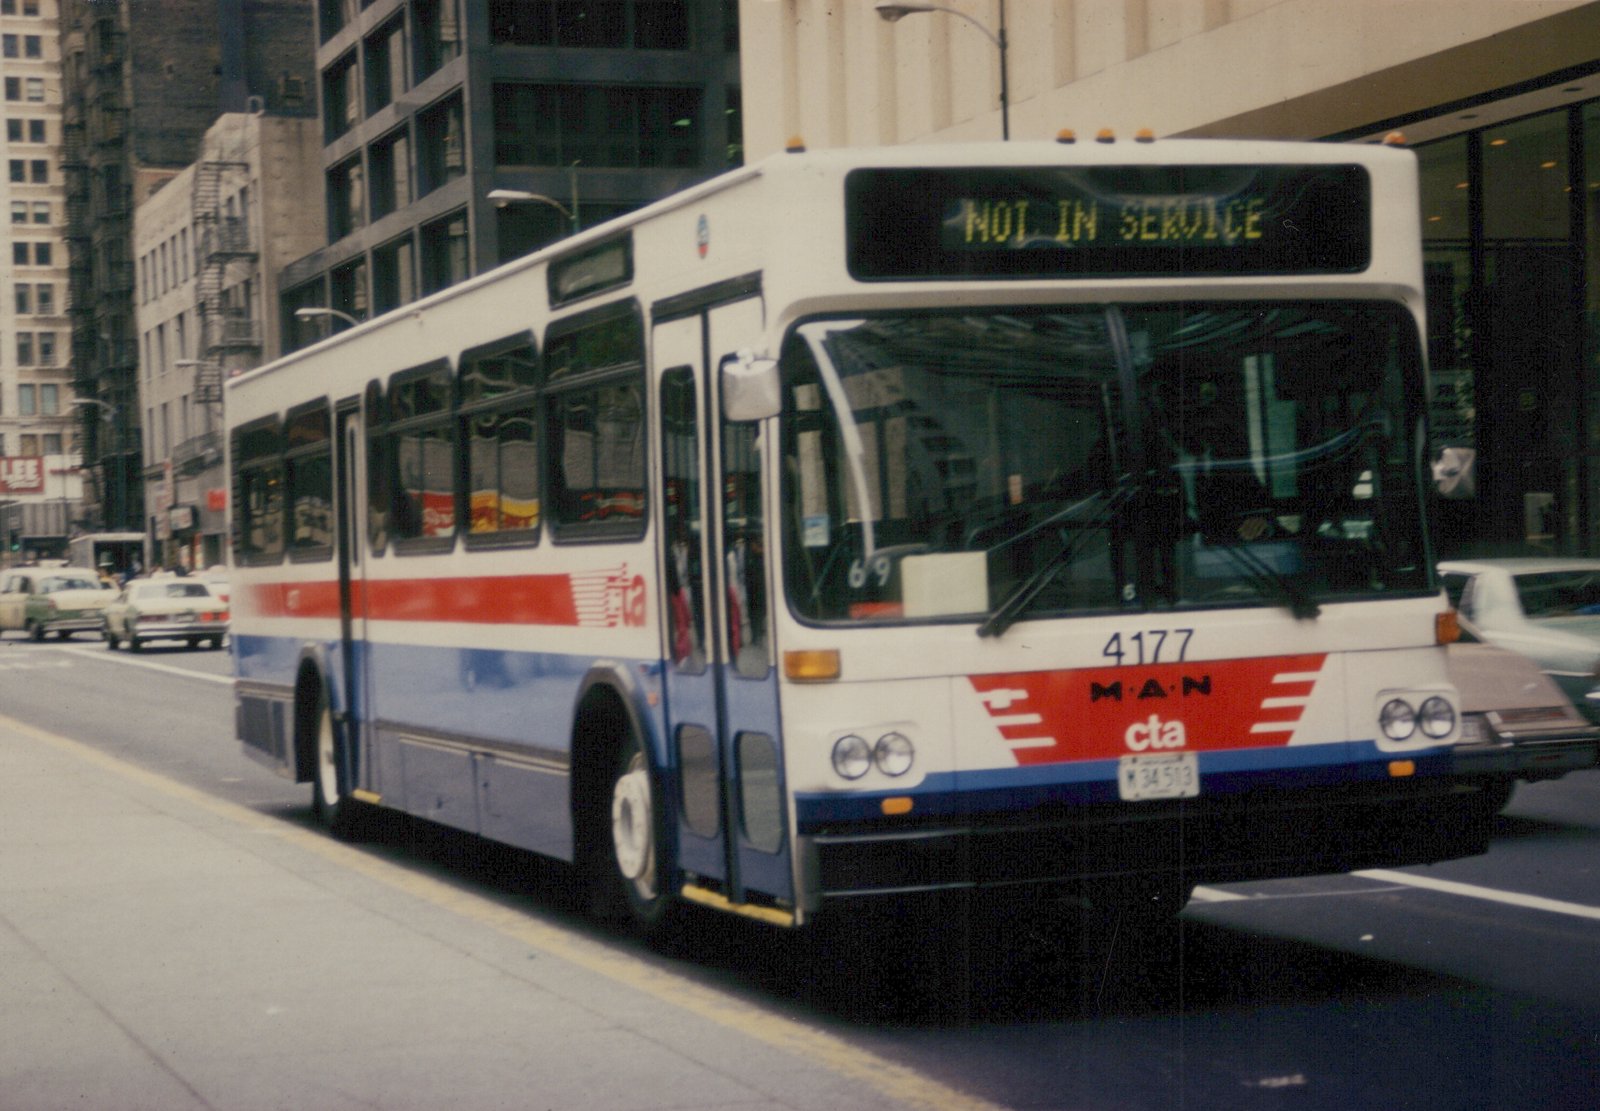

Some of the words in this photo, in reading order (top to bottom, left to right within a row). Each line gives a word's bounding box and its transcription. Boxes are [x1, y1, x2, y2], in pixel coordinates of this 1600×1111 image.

[965, 201, 1029, 242] NOT
[1057, 200, 1097, 240] IN
[1120, 199, 1264, 240] SERVICE
[849, 557, 890, 588] 69
[1102, 628, 1194, 666] 4177
[1125, 714, 1186, 751] cta
